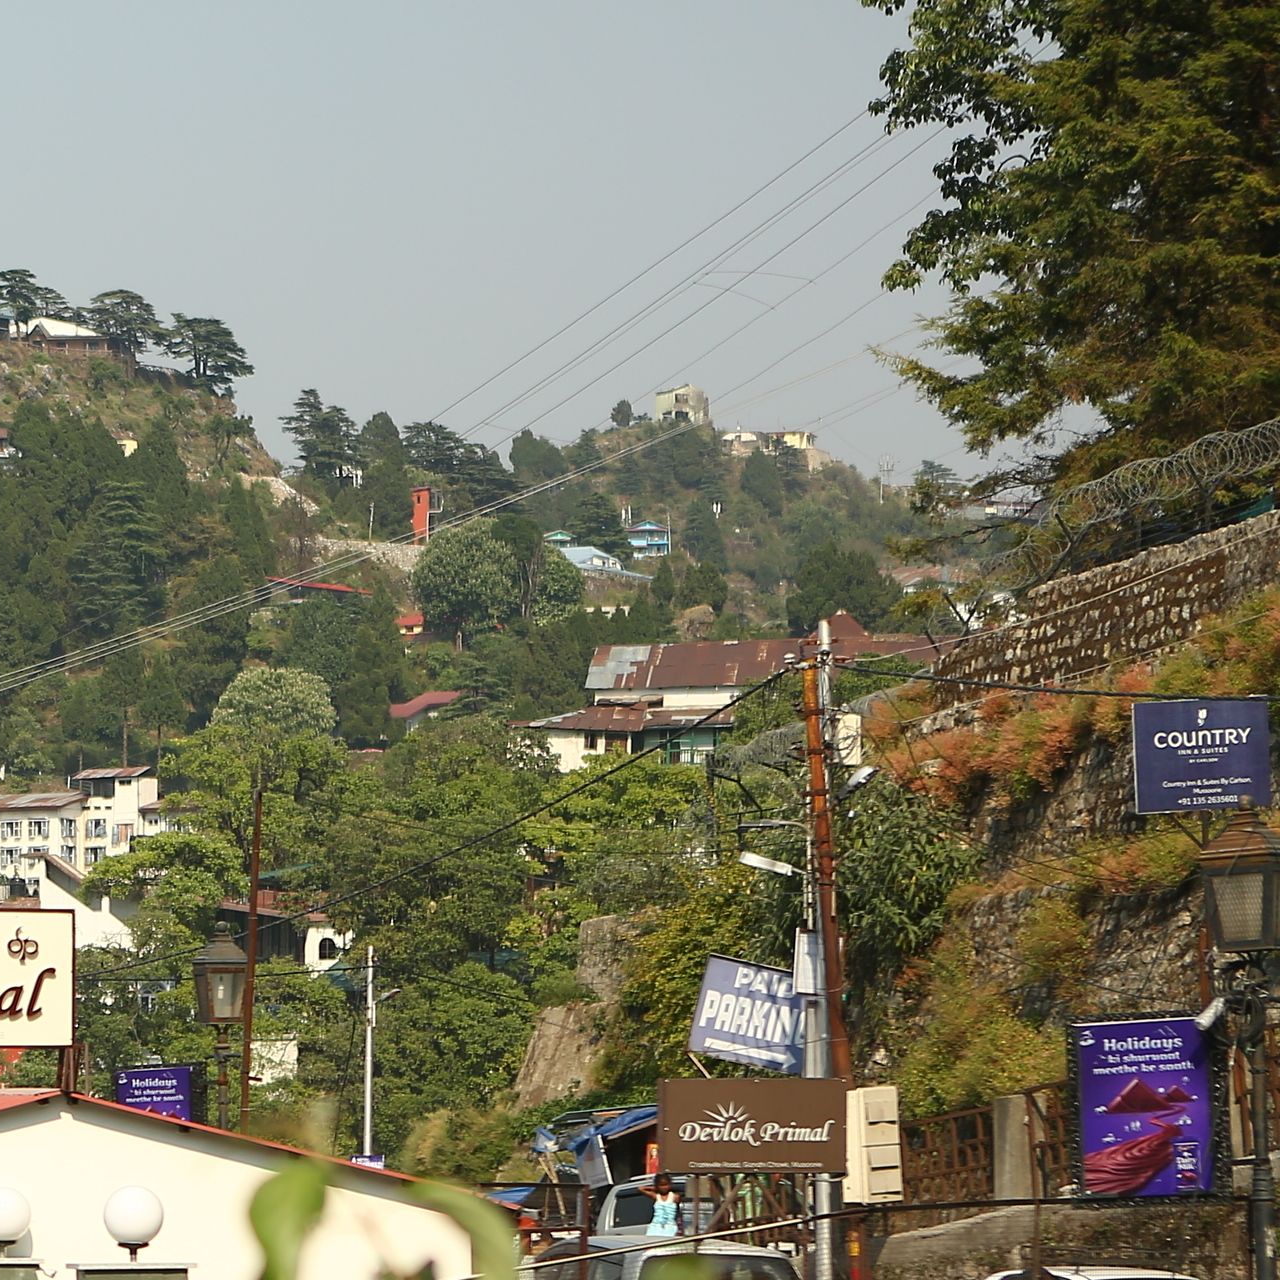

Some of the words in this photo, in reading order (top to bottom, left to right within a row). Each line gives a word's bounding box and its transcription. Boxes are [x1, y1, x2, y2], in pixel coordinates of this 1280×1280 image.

[734, 966, 795, 999] PAID
[1102, 1036, 1183, 1052] Holidays
[132, 1078, 178, 1089] Holidays
[678, 1119, 761, 1147] Devlok
[760, 1120, 836, 1142] Primal
